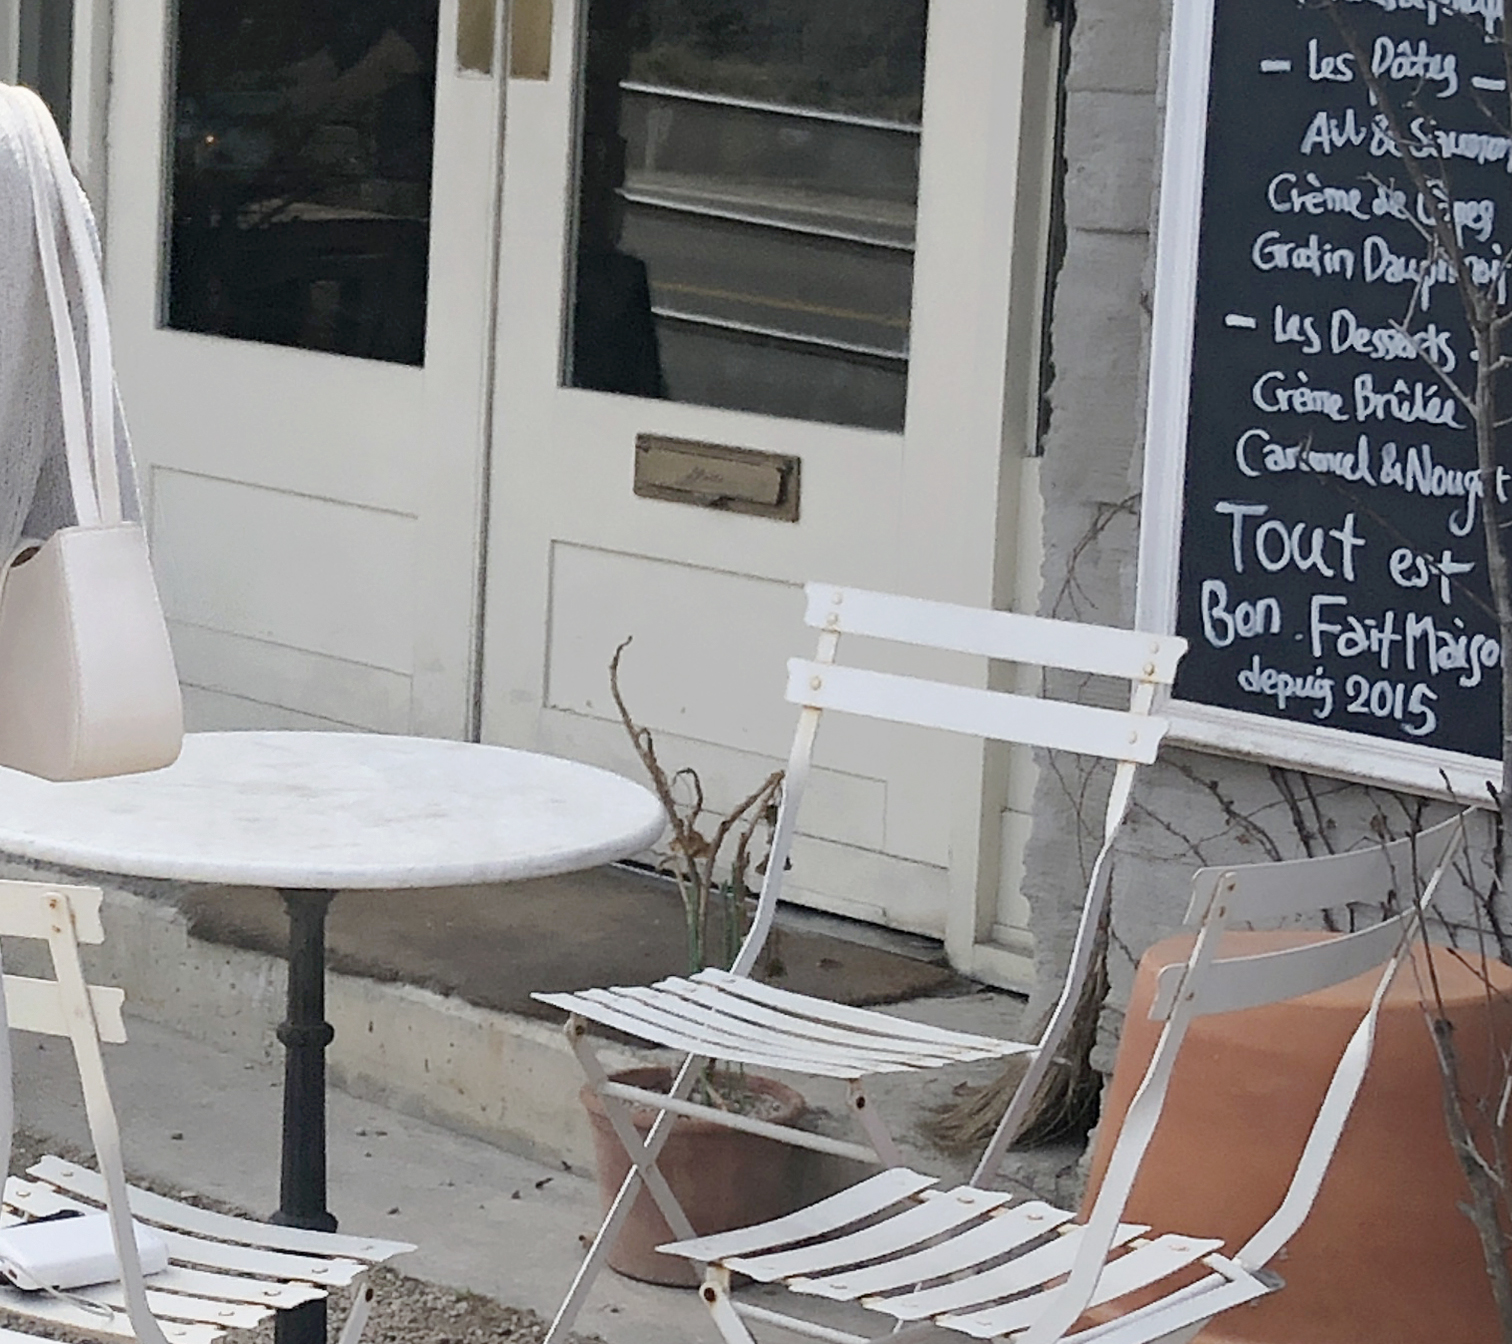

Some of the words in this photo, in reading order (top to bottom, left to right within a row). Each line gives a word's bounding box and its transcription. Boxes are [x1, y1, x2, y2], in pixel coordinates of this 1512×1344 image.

[1268, 172, 1371, 221] Crème
[1252, 230, 1355, 279] Gratin
[1252, 370, 1350, 421] Crème
[1214, 501, 1367, 582] Tout
[1389, 547, 1476, 605] est
[1310, 594, 1402, 671] Fait
[1345, 674, 1439, 736] 2015
